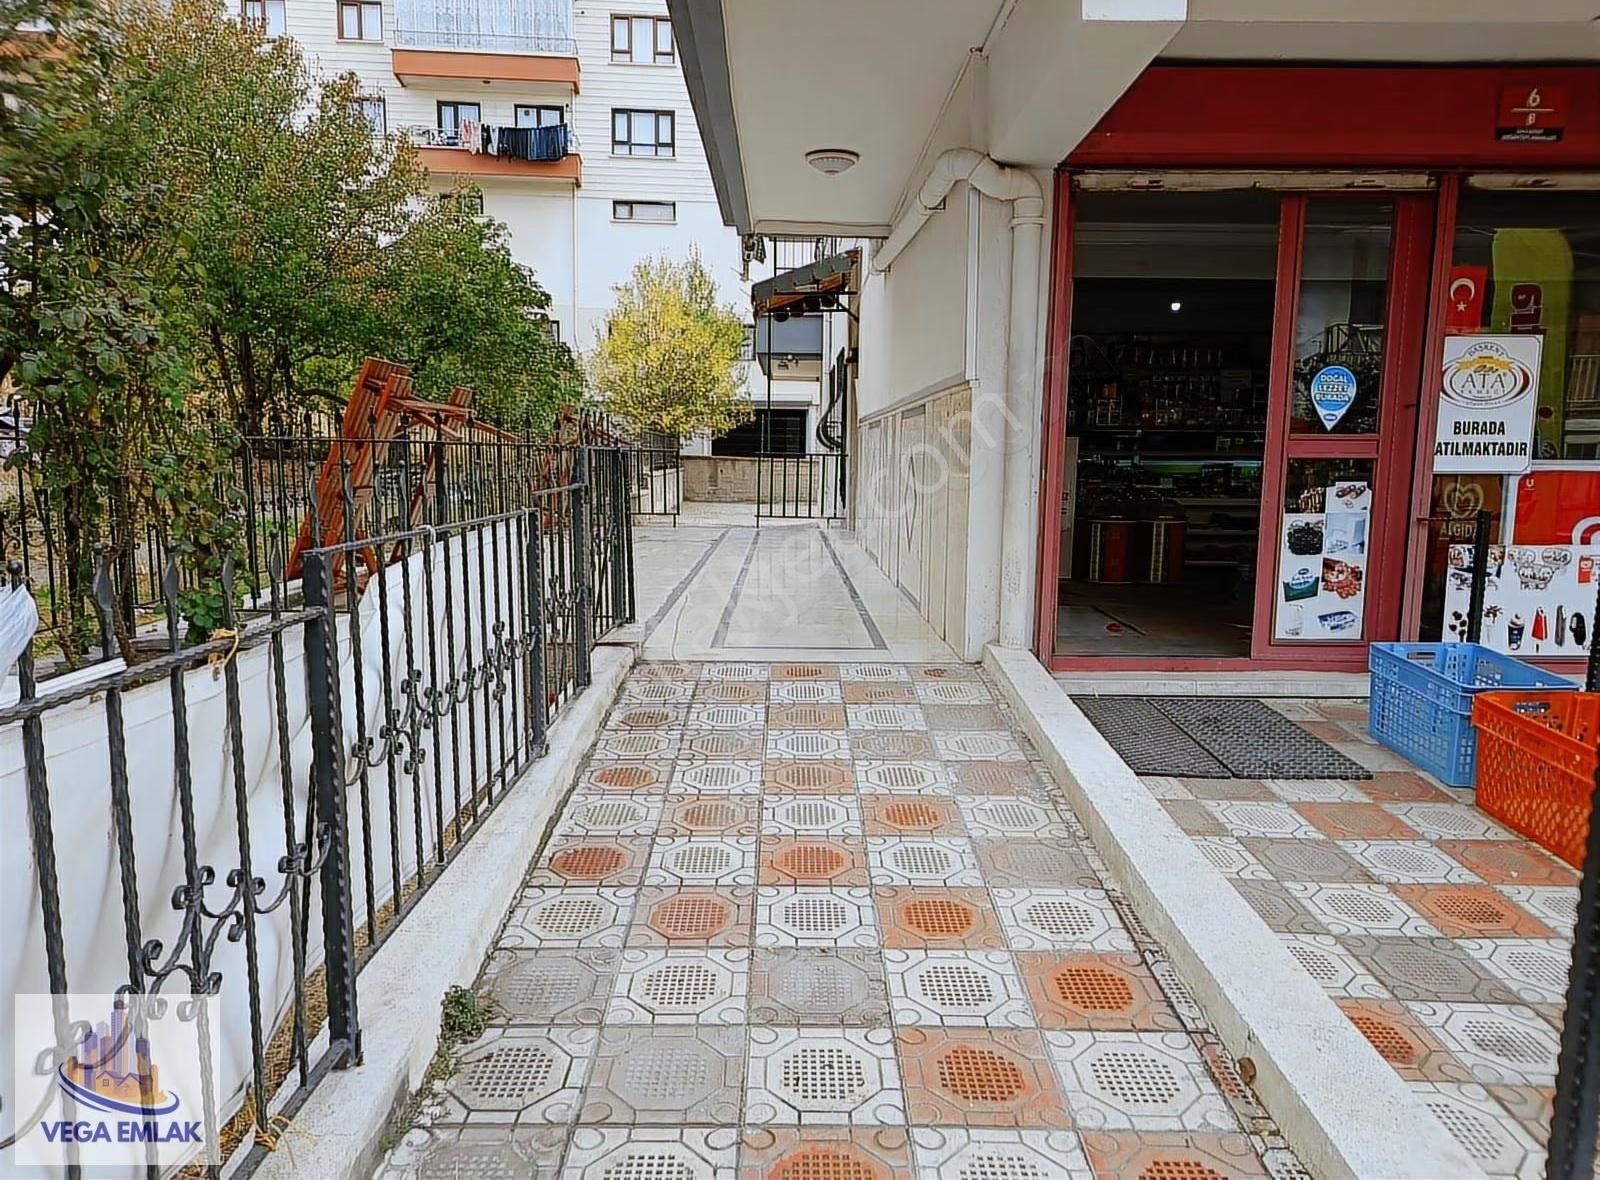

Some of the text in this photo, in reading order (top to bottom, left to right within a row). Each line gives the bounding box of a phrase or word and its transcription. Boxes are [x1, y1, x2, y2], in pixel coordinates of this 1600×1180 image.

[1527, 88, 1540, 107] 6
[1461, 373, 1505, 389] ATA
[1453, 421, 1505, 435] BURADA
[1435, 442, 1528, 456] ATILMAKTADIR
